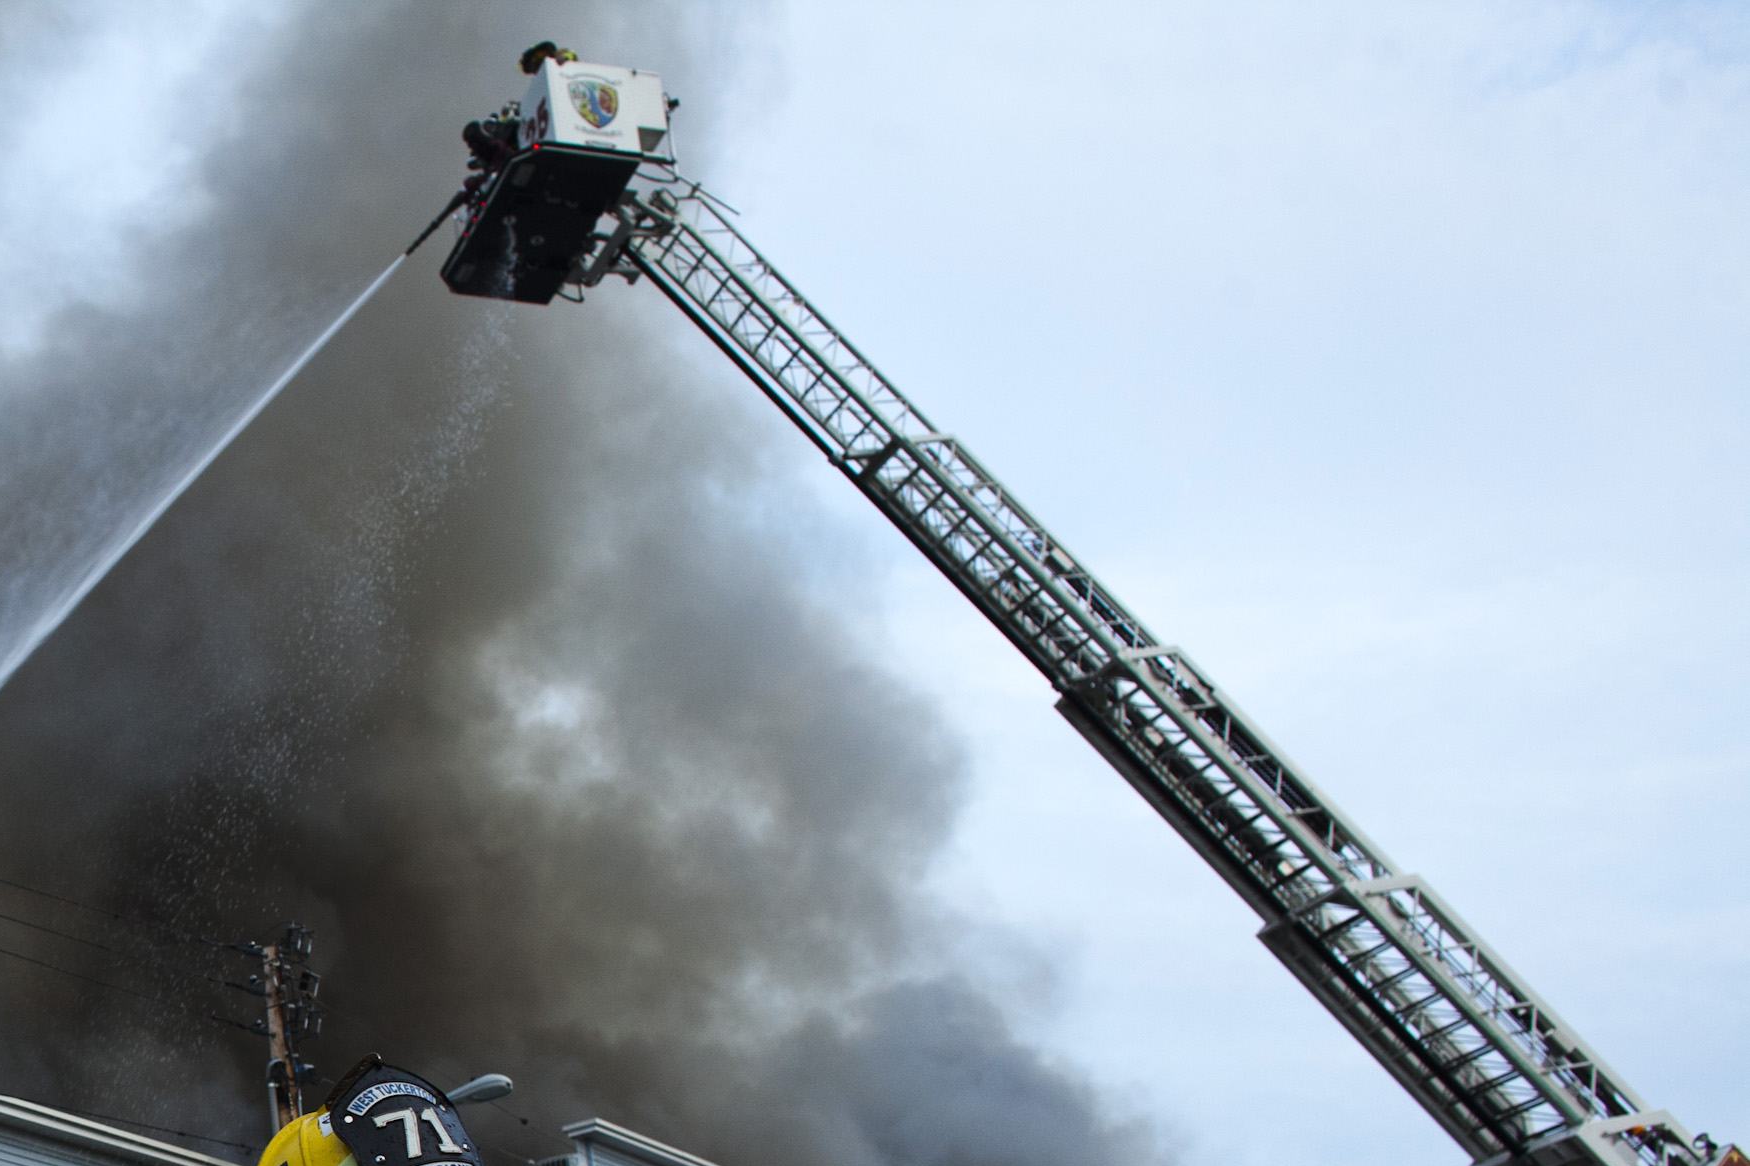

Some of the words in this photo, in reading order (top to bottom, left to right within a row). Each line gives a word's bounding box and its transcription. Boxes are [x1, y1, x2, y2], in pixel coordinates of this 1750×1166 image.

[350, 1089, 379, 1114] WEST
[375, 1082, 436, 1104] TUCKERTON
[372, 1107, 463, 1159] 71
